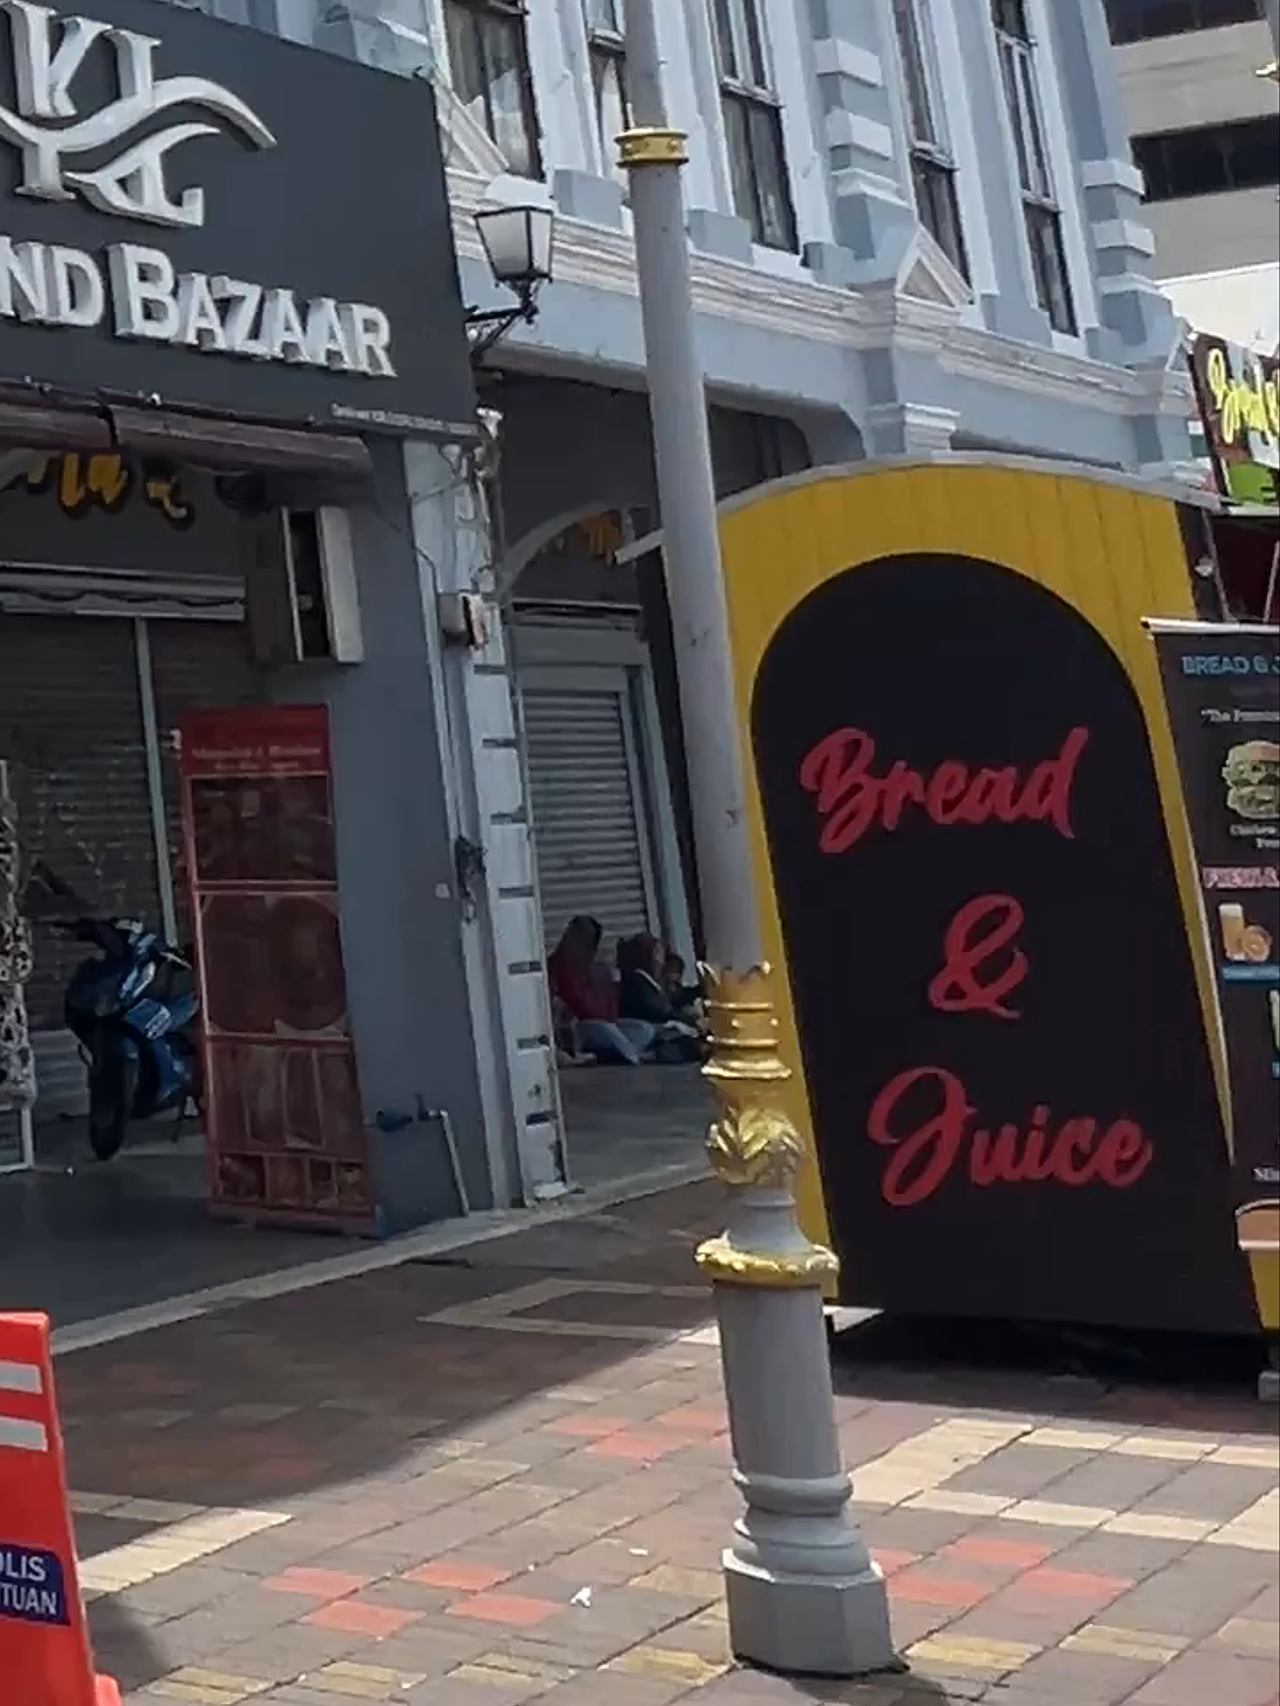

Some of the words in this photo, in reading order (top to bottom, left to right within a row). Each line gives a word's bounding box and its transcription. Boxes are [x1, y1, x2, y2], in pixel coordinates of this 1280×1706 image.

[107, 242, 397, 376] BAZAAR
[1181, 655, 1250, 676] BREAD
[801, 725, 1089, 854] Bread
[927, 893, 1032, 1020] &
[867, 1065, 1154, 1208] Juice
